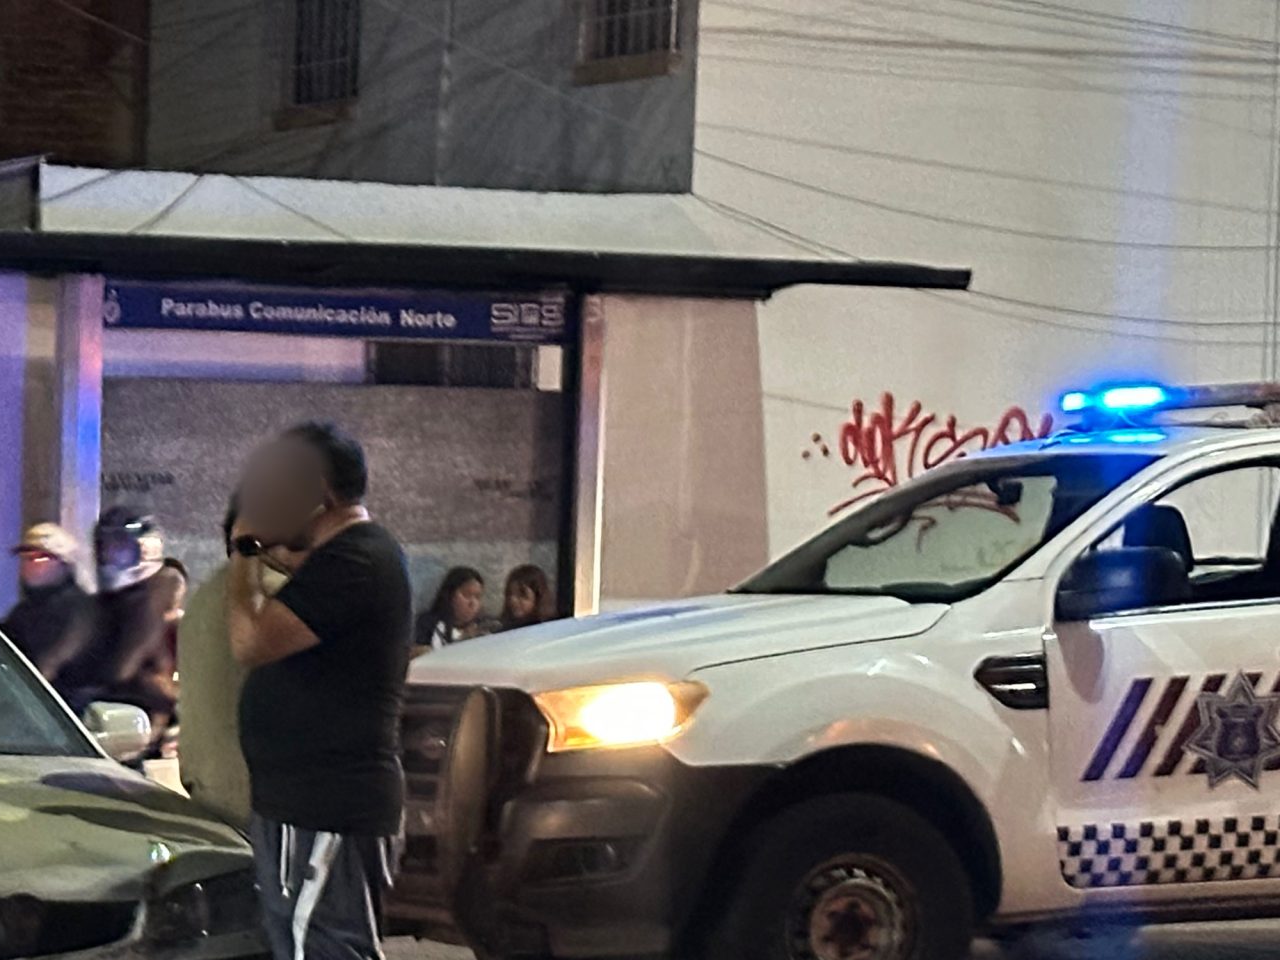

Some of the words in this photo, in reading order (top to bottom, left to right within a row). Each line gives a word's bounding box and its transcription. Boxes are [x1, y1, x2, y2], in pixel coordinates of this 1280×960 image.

[161, 298, 244, 318] Parabus
[249, 301, 391, 326] Comunicación
[400, 308, 457, 328] Norte
